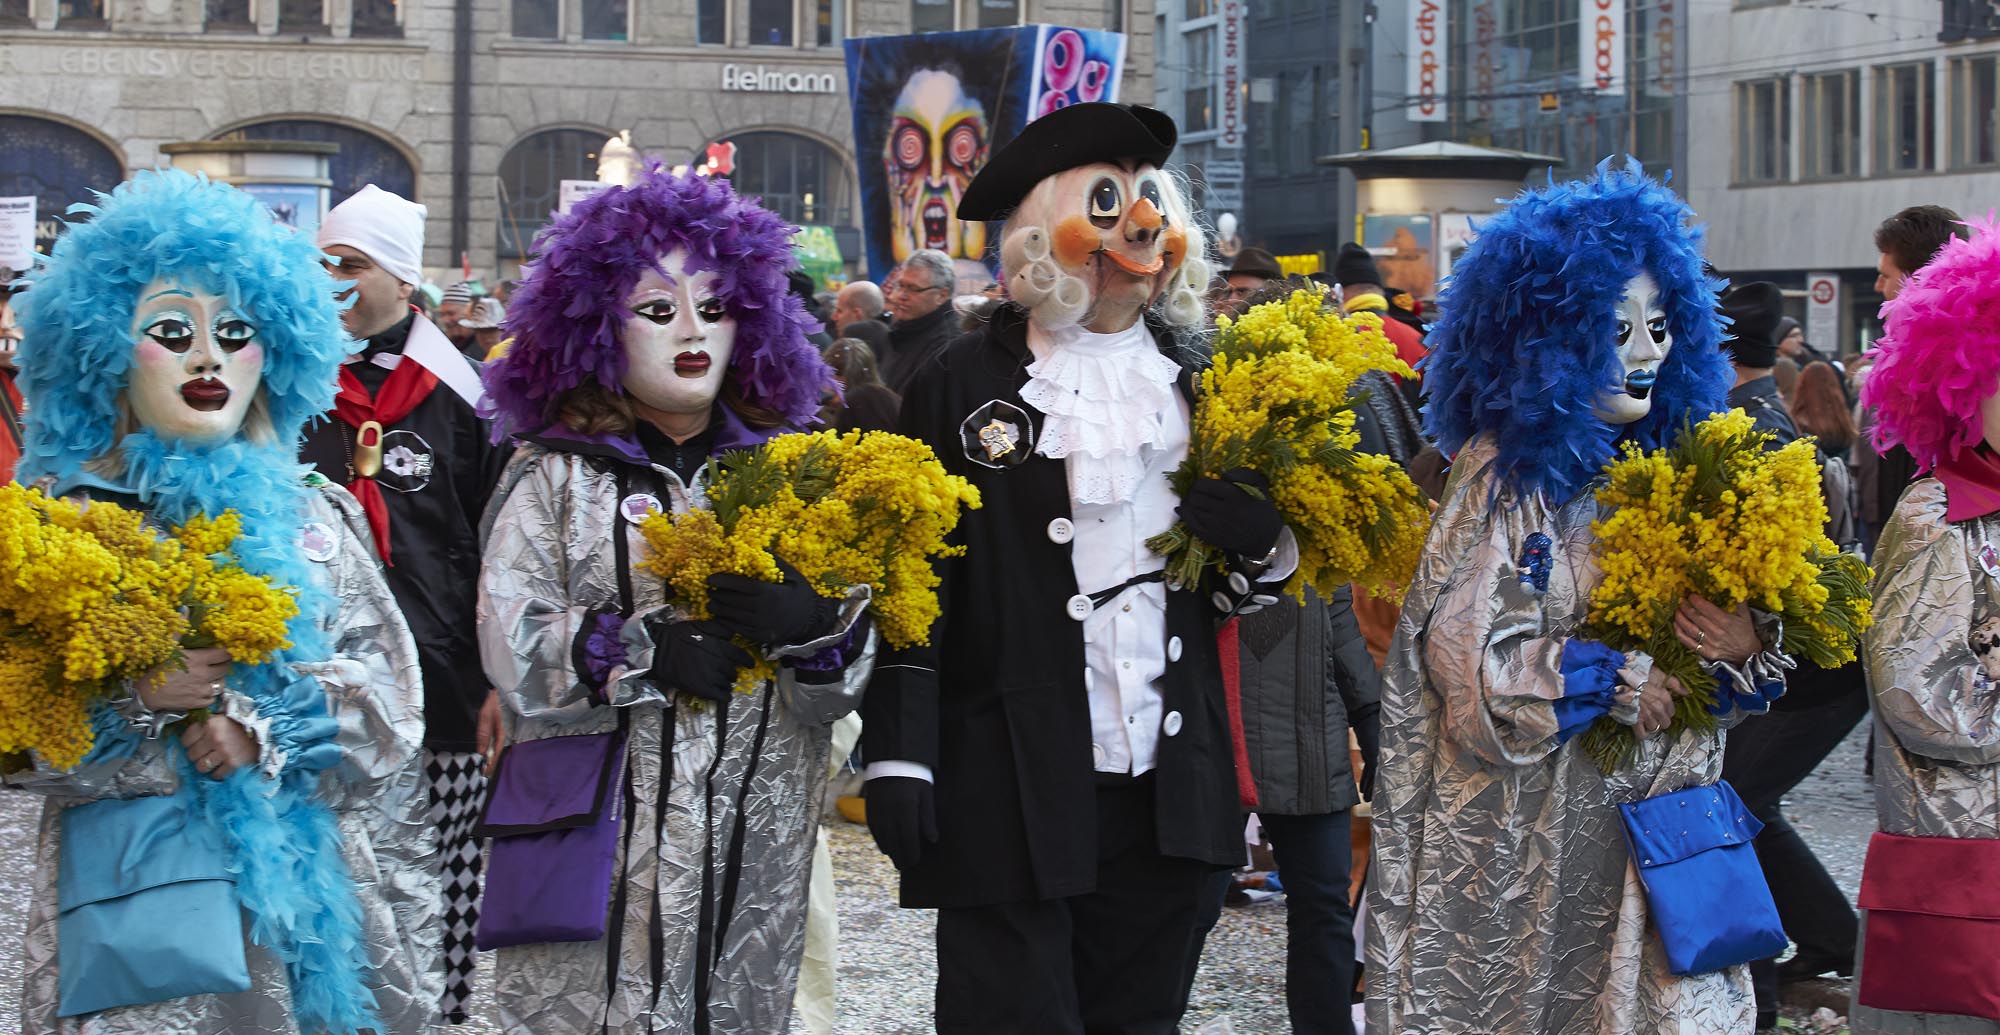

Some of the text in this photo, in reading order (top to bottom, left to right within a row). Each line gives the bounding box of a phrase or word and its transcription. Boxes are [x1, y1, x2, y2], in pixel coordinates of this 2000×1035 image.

[39, 51, 423, 80] LEBENSVERSICHERUNG
[1225, 2, 1238, 144] OCHSNER SHOES
[1415, 0, 1440, 116] coop city
[1595, 15, 1617, 89] coop
